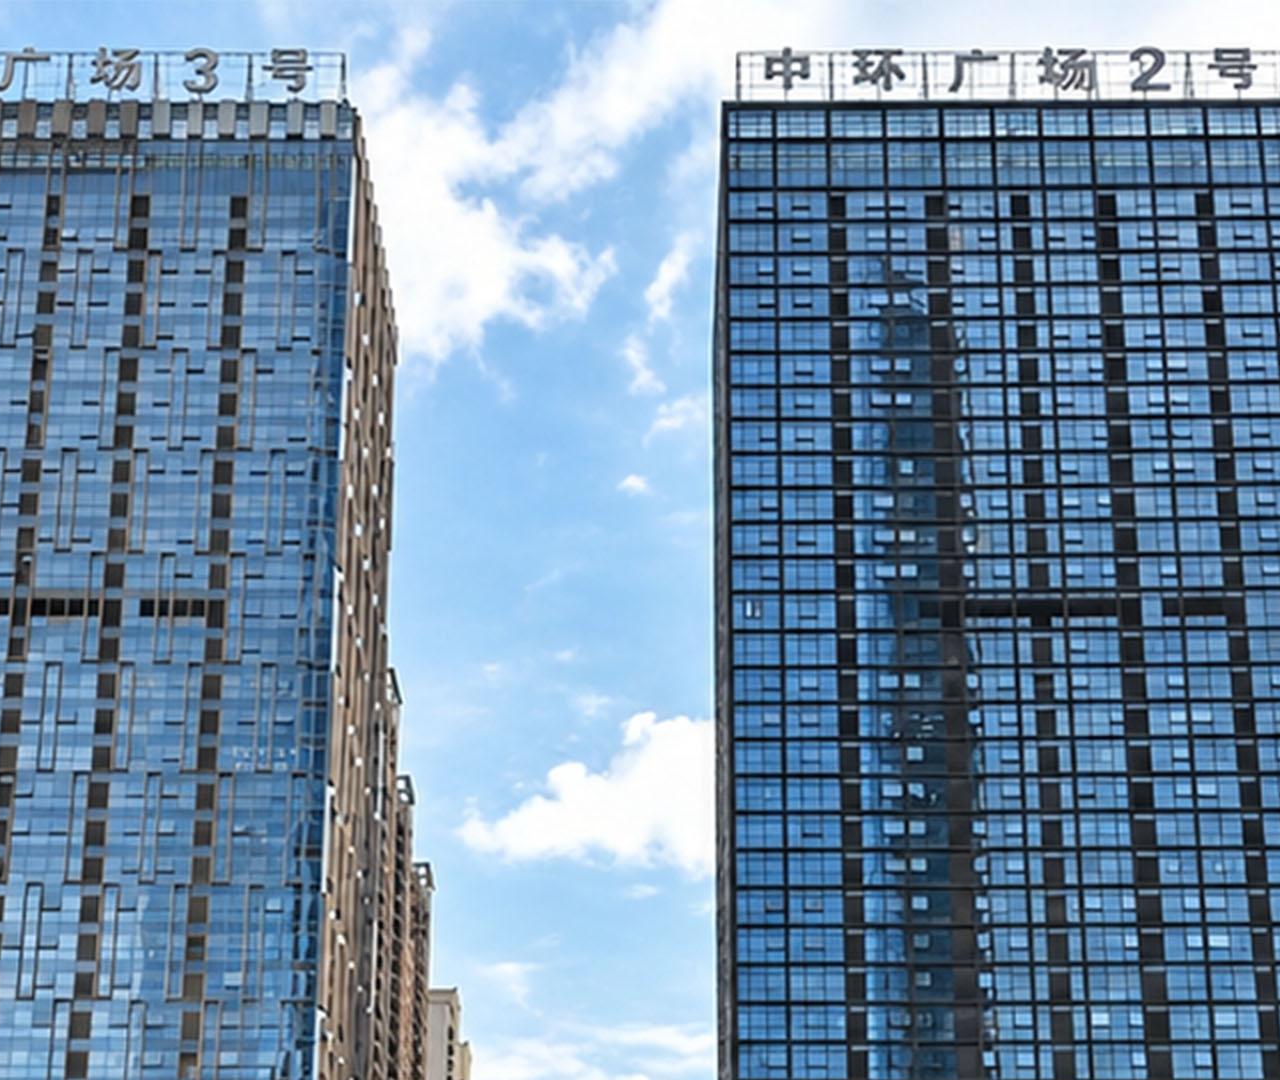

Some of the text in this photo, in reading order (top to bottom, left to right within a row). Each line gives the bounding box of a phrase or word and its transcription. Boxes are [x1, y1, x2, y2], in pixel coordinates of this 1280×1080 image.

[764, 47, 1258, 92] 中环广场2号
